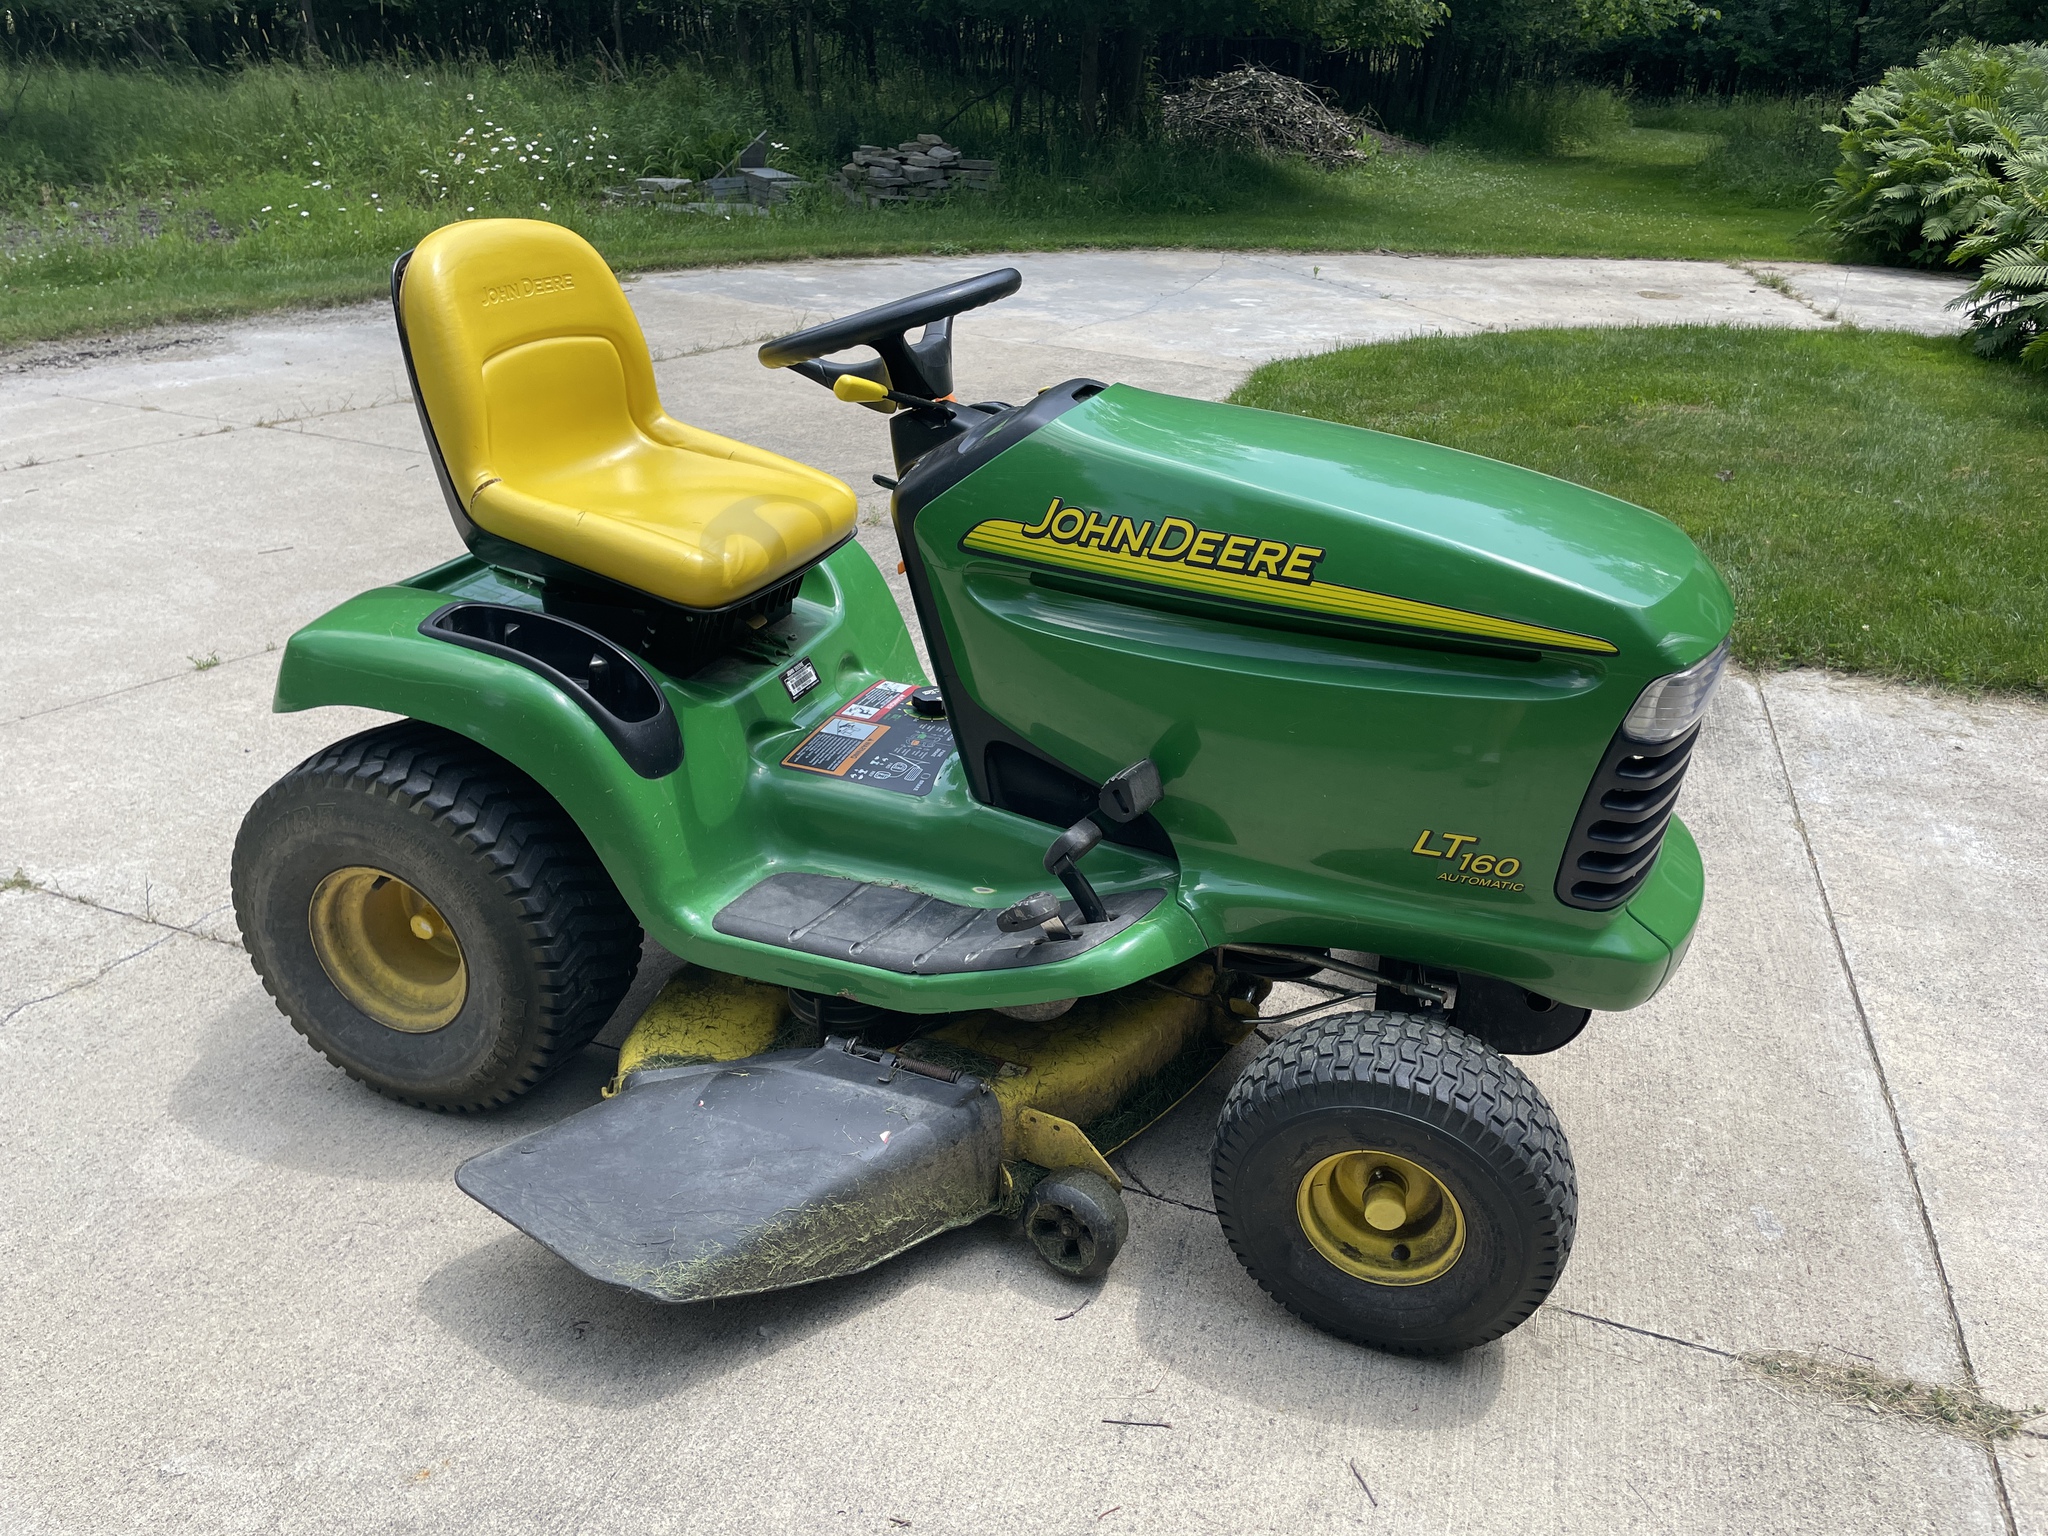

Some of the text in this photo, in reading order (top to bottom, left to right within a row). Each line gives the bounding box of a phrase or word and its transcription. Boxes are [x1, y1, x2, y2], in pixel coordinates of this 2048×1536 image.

[482, 273, 575, 307] JOHN DEERE
[1436, 871, 1526, 893] AUTOMATIC
